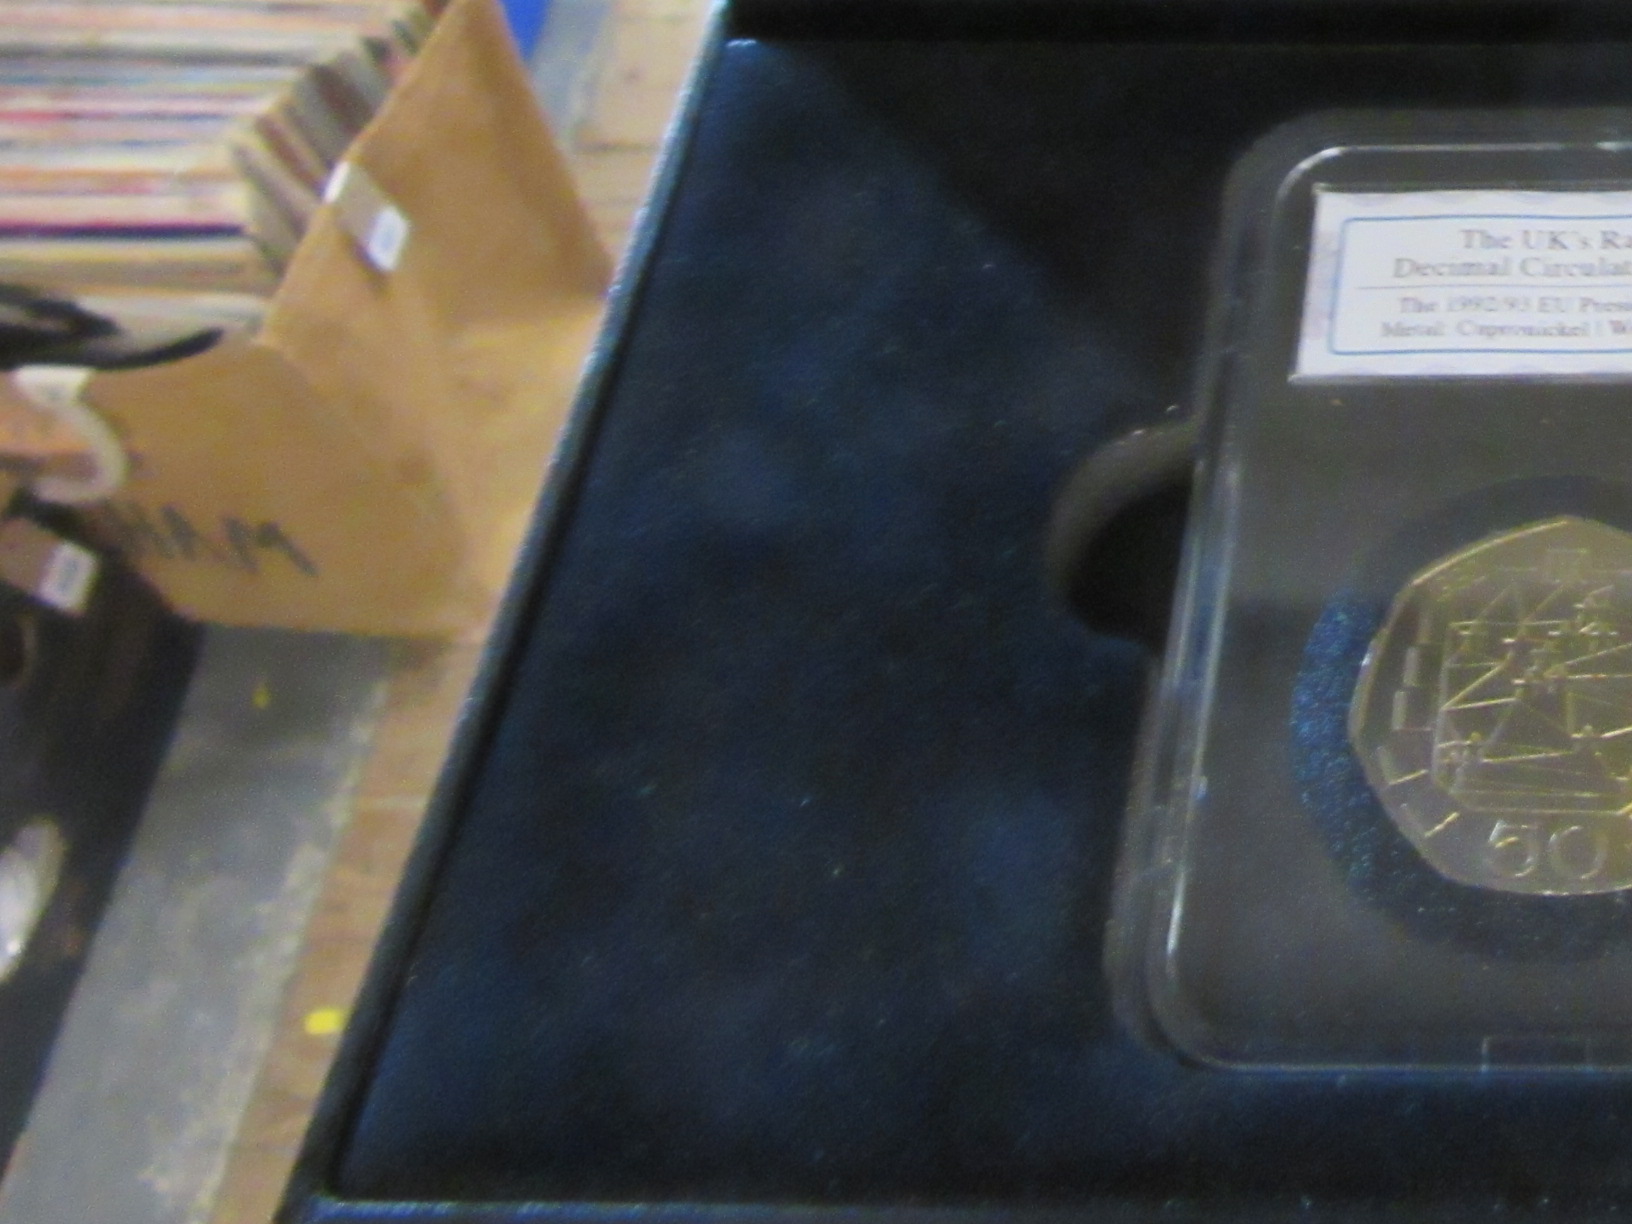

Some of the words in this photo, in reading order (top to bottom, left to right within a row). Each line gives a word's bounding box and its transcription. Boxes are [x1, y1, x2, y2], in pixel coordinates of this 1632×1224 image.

[1460, 229, 1513, 250] The
[1522, 229, 1592, 251] UK's
[1393, 256, 1512, 278] Decimal
[1400, 296, 1440, 314] The
[1538, 295, 1574, 313] EU
[1487, 818, 1608, 878] 50
